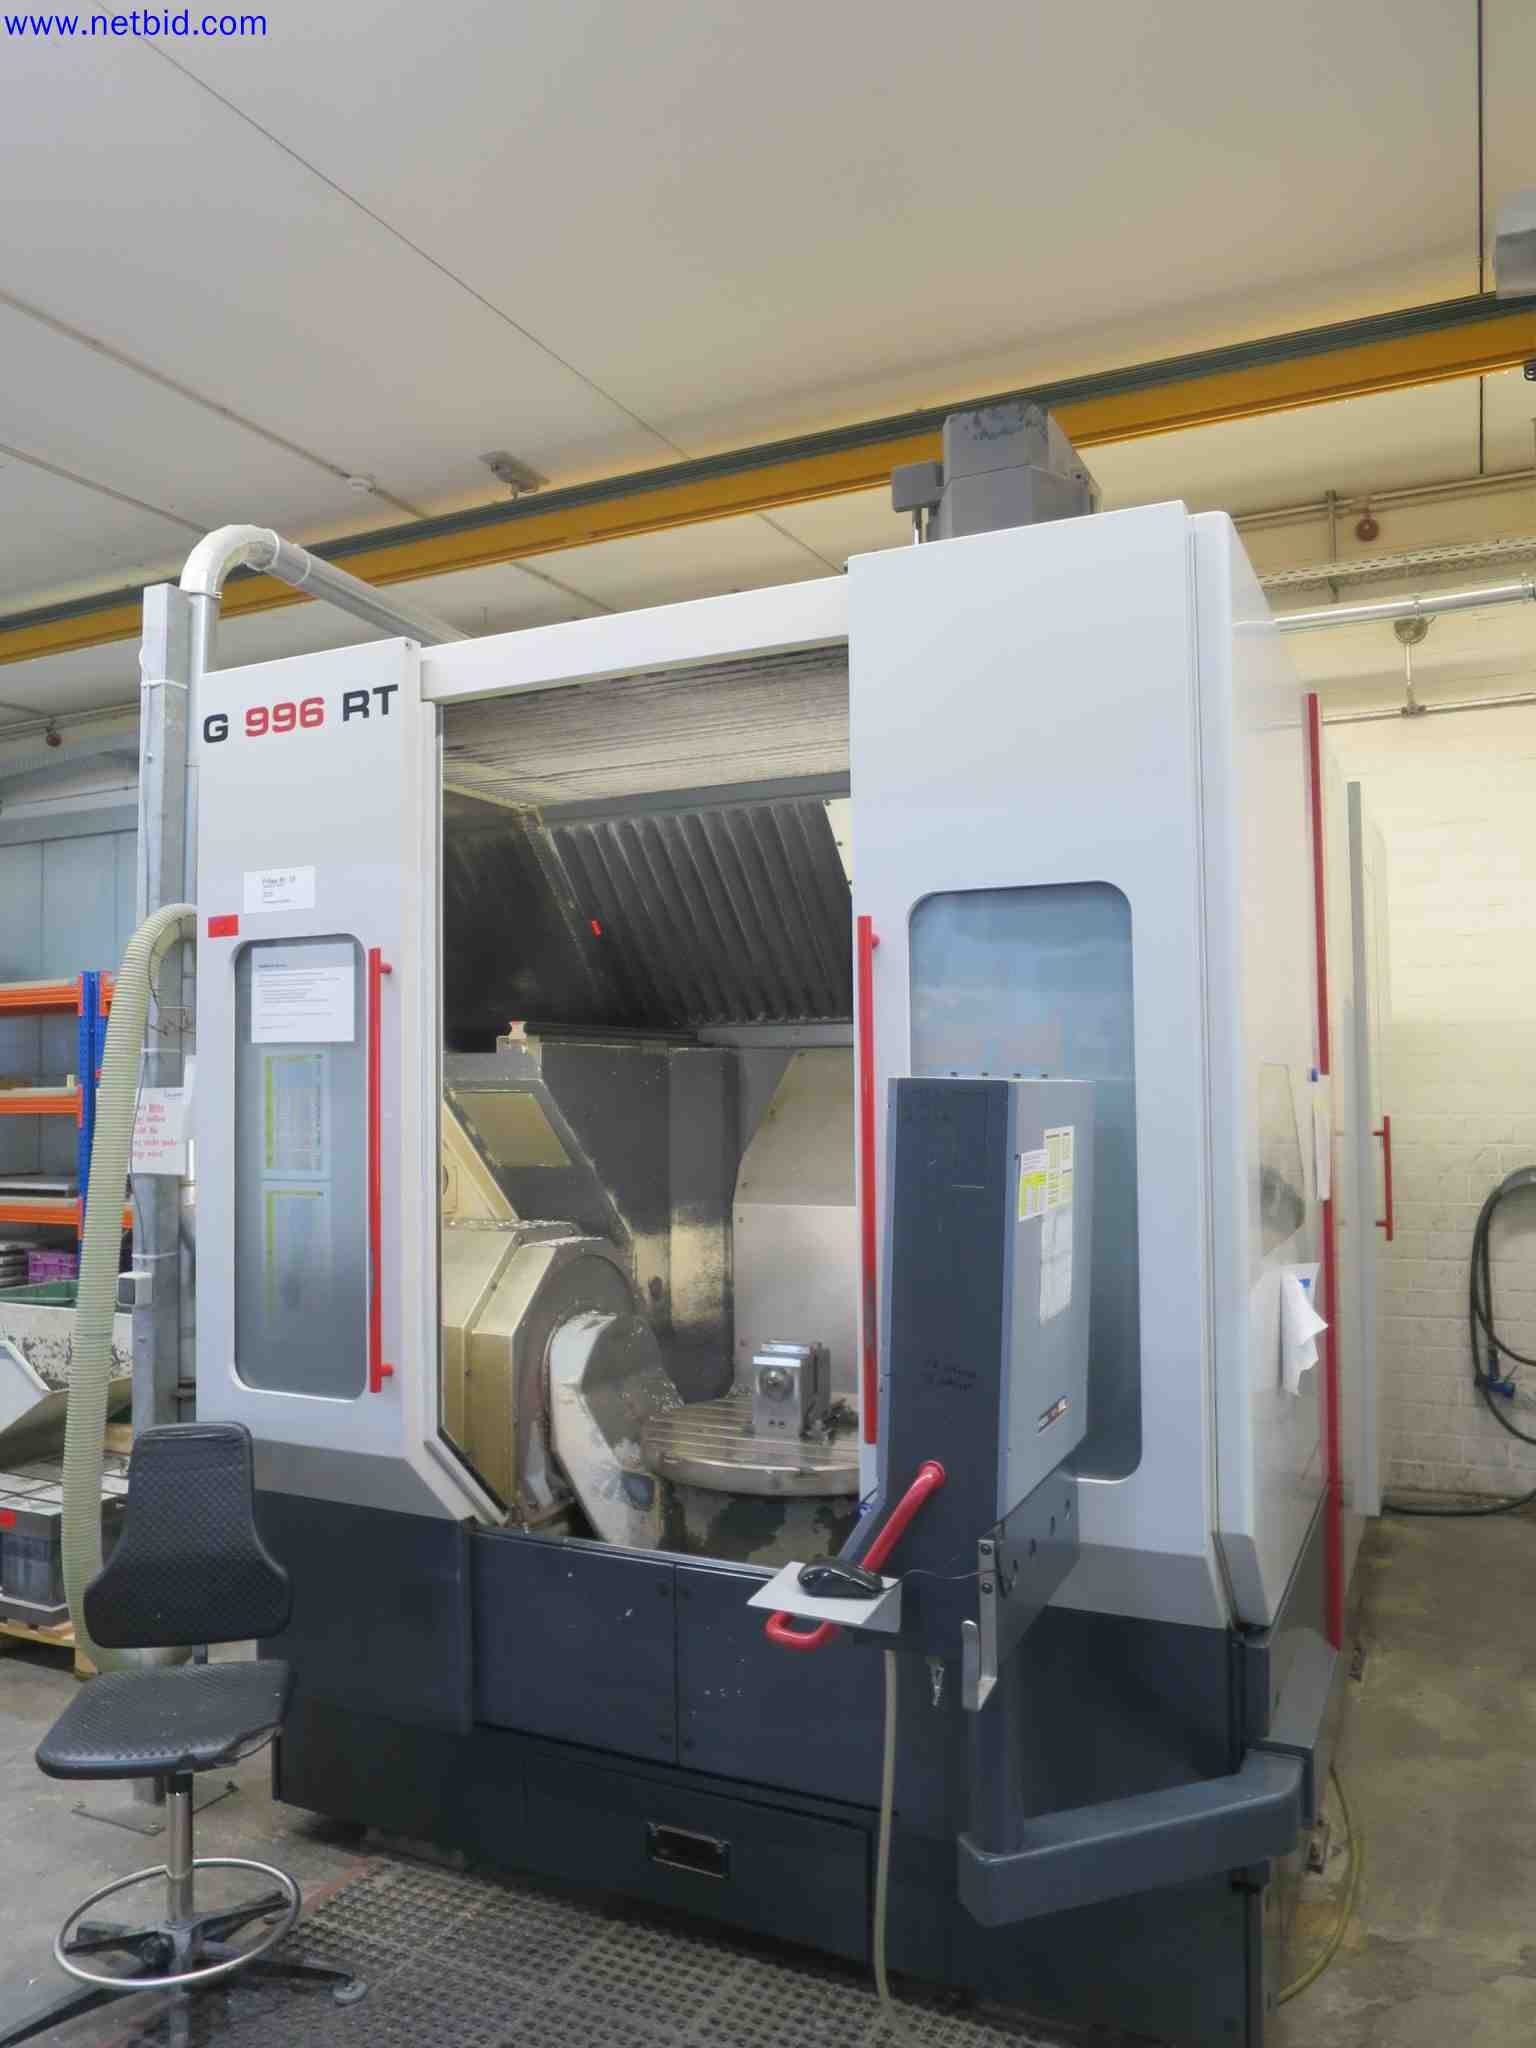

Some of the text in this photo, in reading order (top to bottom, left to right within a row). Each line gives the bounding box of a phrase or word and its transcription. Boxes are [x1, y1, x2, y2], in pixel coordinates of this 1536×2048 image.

[203, 684, 399, 744] G 996 RT
